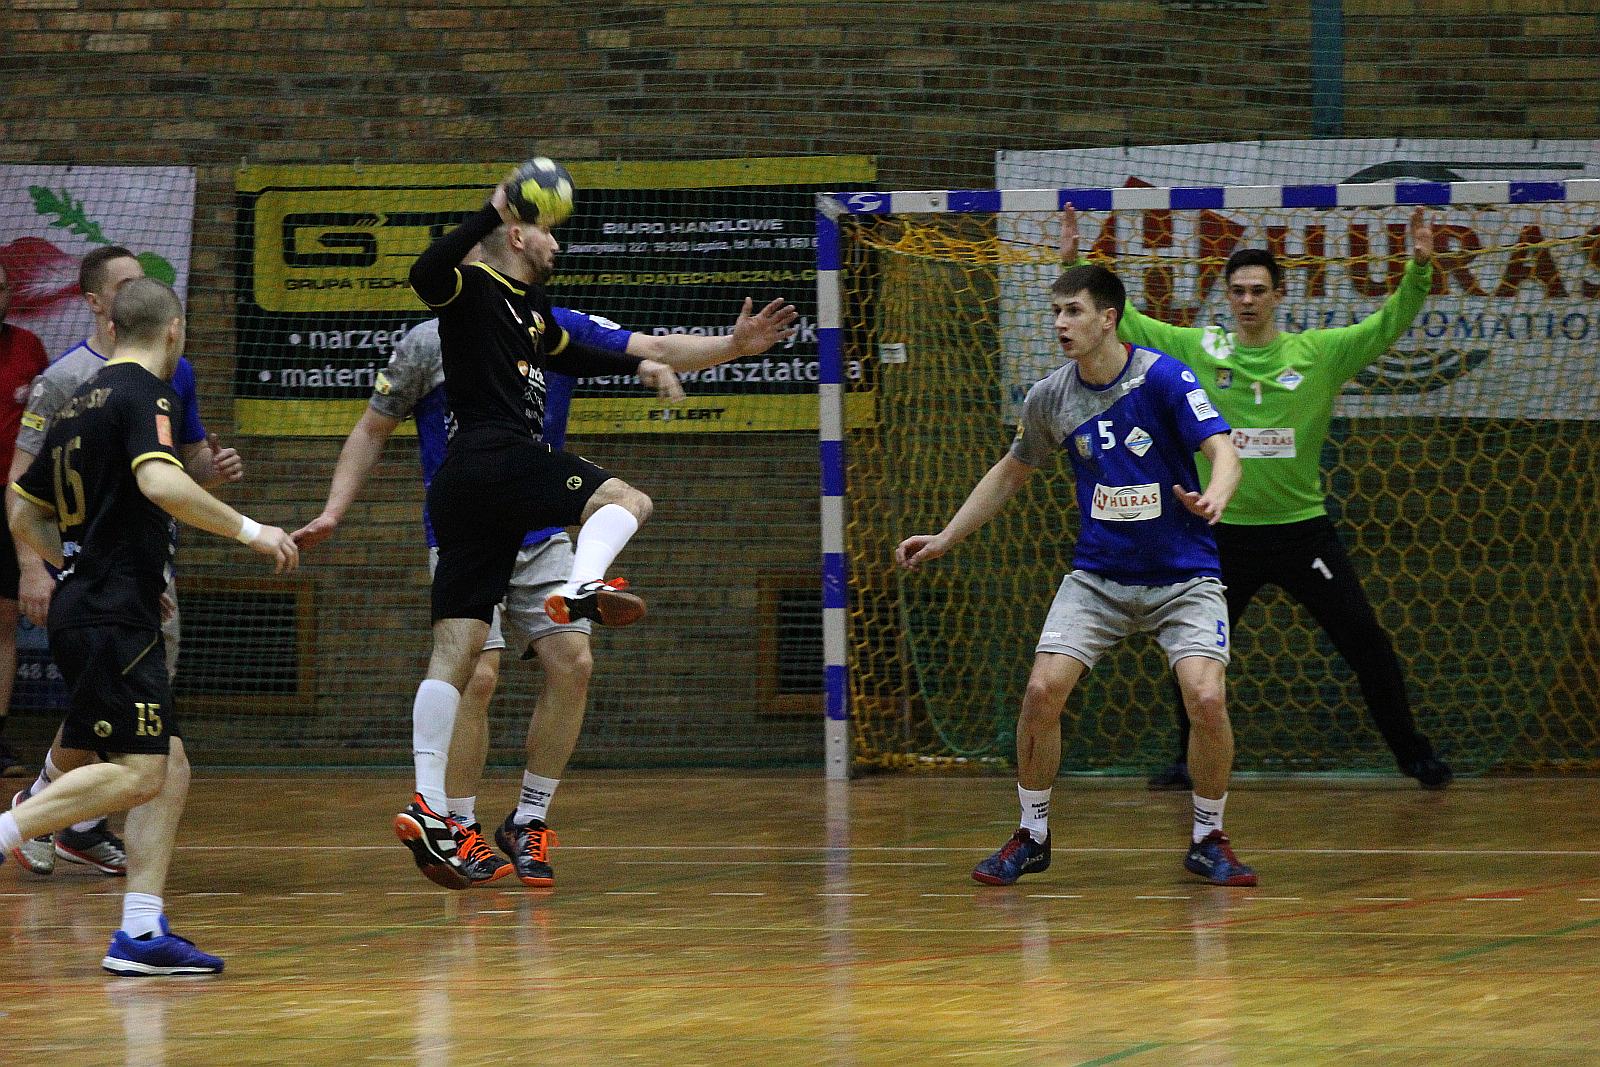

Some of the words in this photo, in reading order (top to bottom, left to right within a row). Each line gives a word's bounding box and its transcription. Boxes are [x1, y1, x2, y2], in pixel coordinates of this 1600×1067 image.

[603, 222, 665, 234] BIURO
[670, 219, 784, 233] HANDLOWE
[1266, 223, 1600, 297] HURA
[284, 278, 353, 291] GRUPA
[356, 276, 412, 290] TECH
[1250, 381, 1263, 405] 1
[1098, 421, 1117, 450] 5
[1110, 493, 1159, 508] HURAS
[1311, 557, 1333, 580] 1
[1215, 619, 1226, 648] 5
[134, 702, 163, 737] 15
